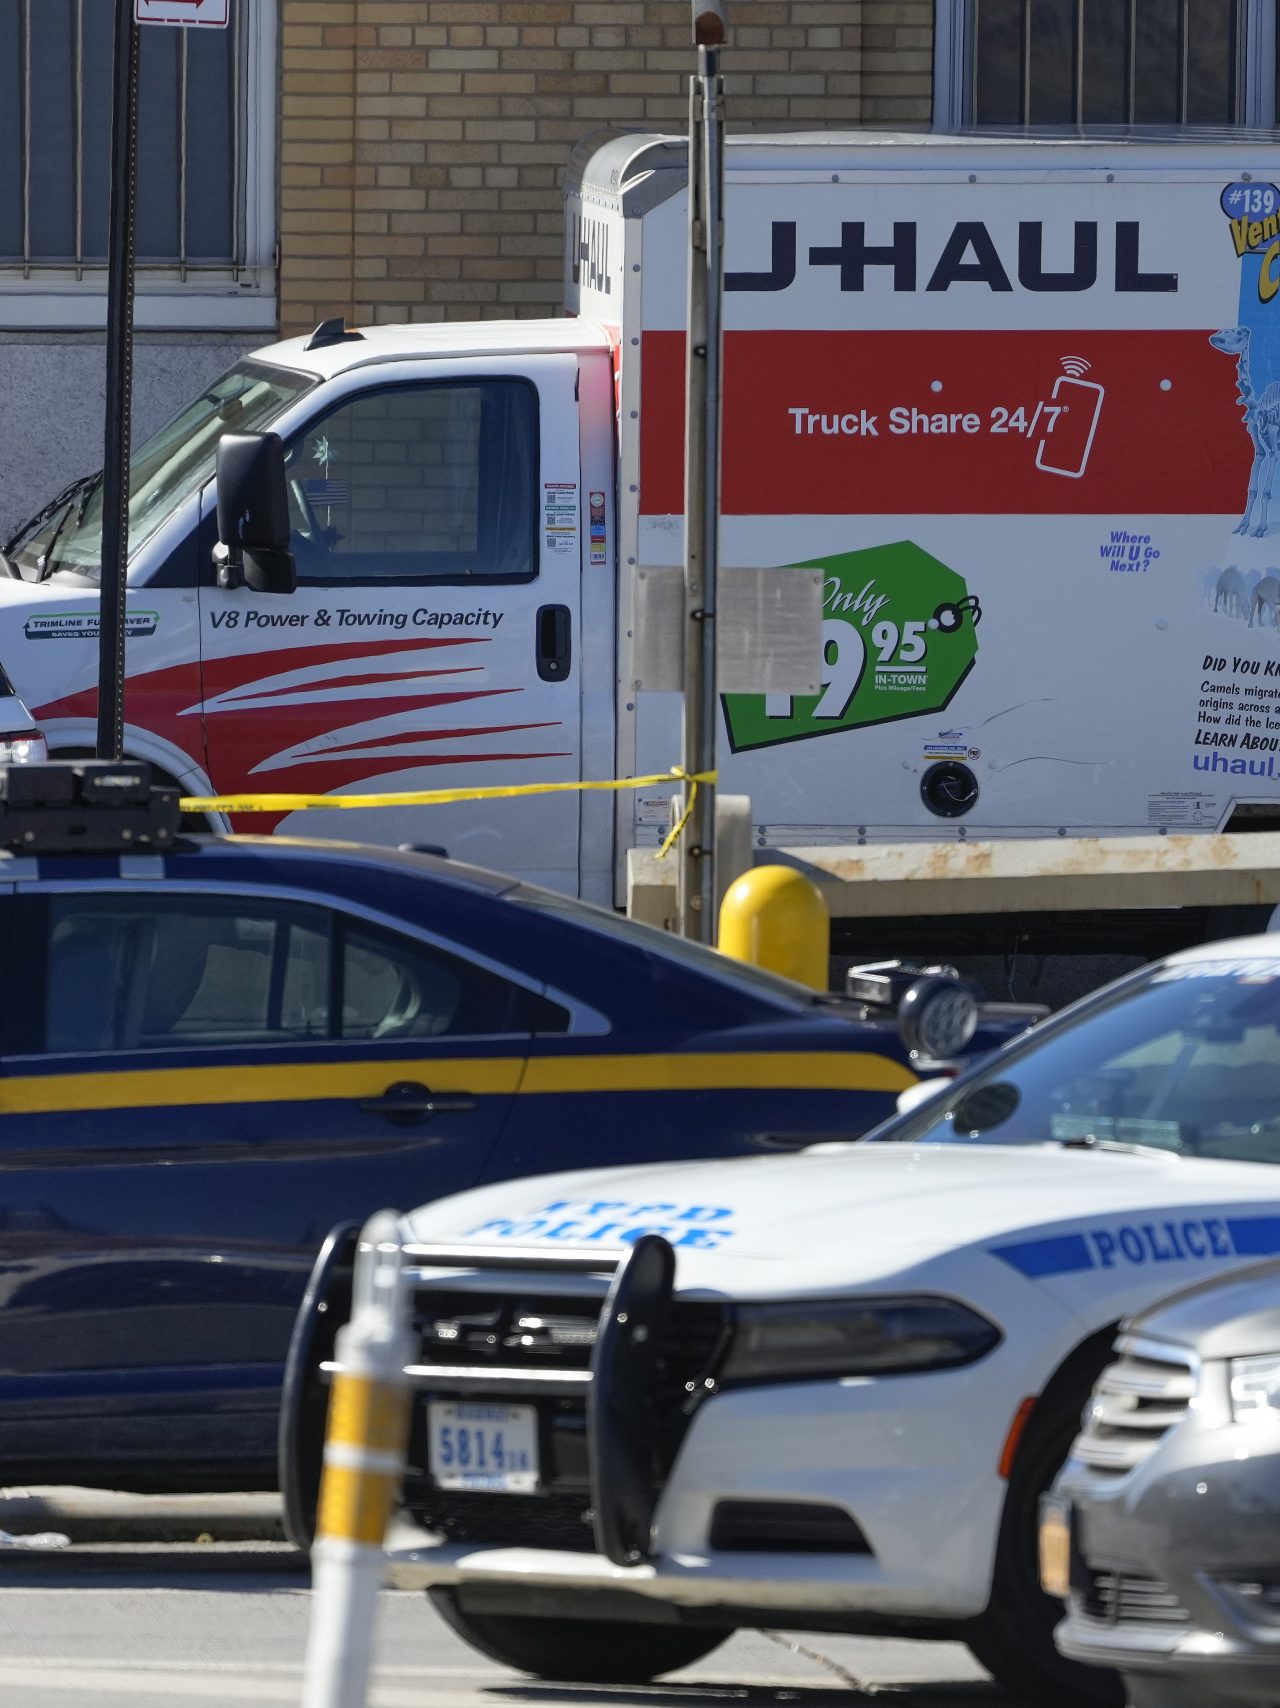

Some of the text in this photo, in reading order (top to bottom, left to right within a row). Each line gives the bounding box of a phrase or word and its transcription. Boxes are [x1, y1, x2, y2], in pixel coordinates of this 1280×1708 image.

[1228, 188, 1275, 214] #139
[1228, 207, 1280, 258] Ven
[788, 407, 879, 436] Truck
[888, 406, 981, 435] Share
[1110, 530, 1151, 544] Where
[1100, 544, 1160, 561] Will U Go
[33, 619, 83, 628] TRIMLINE
[125, 617, 150, 625] AVER
[210, 607, 504, 629] V8 Power & Towing Capacity
[871, 620, 928, 663] 95
[1202, 655, 1227, 672] DID
[1232, 656, 1261, 675] YOU
[875, 674, 928, 685] IN-TOWN
[1200, 680, 1240, 696] Camels
[1199, 697, 1234, 712] origins
[1238, 702, 1271, 714] across
[1197, 710, 1222, 725] How
[1225, 713, 1241, 726] did
[1245, 715, 1261, 728] the
[1195, 728, 1280, 752] LEARN ABOU
[1090, 1220, 1230, 1270] POLICE
